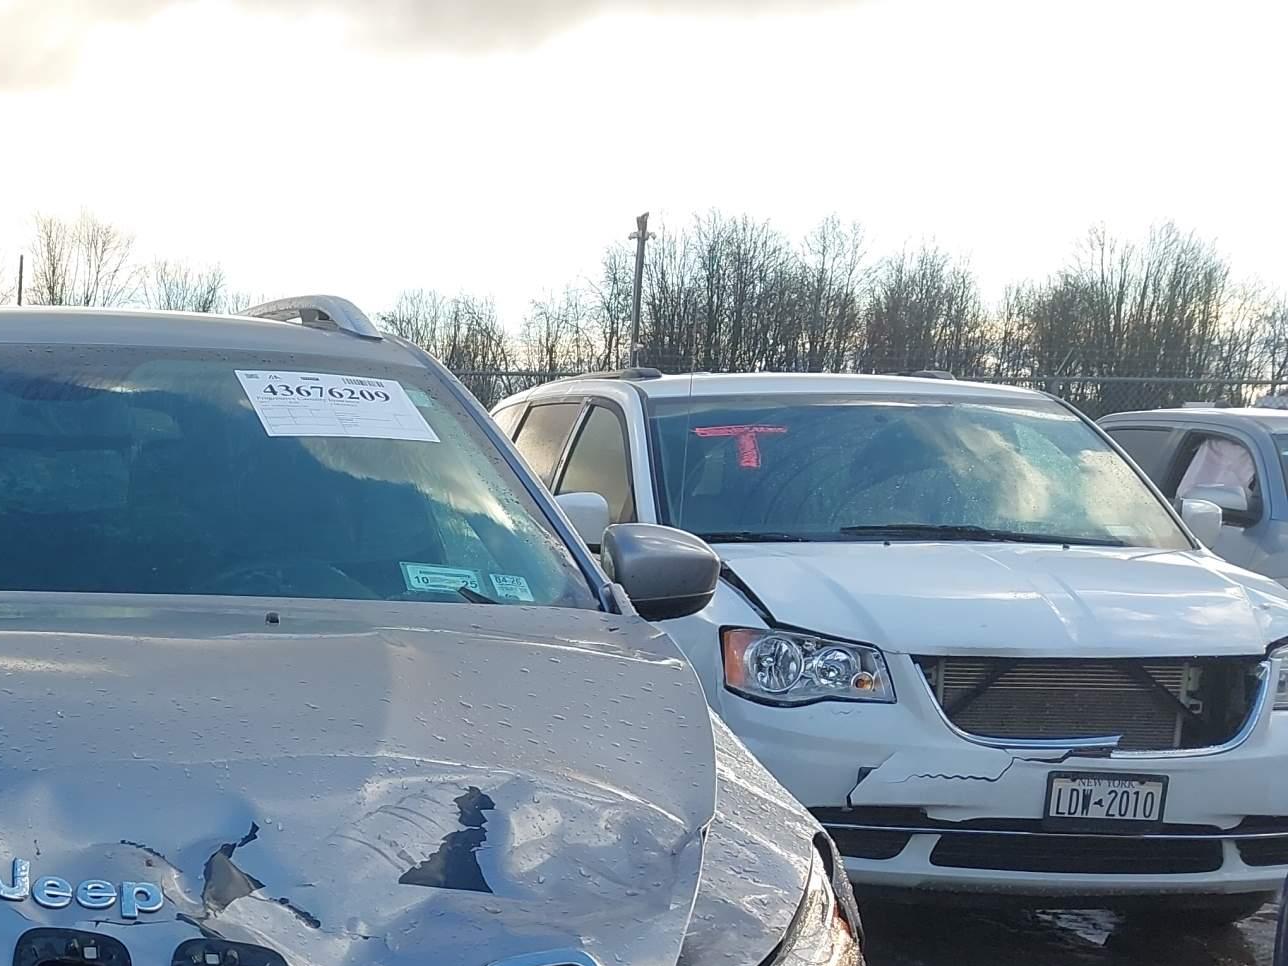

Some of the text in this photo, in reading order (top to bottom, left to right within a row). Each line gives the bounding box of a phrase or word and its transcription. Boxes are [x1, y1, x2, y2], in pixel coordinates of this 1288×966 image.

[263, 384, 391, 403] 43676209
[414, 575, 430, 585] 10
[1078, 778, 1136, 789] NEW YORK
[1105, 790, 1155, 819] 2010
